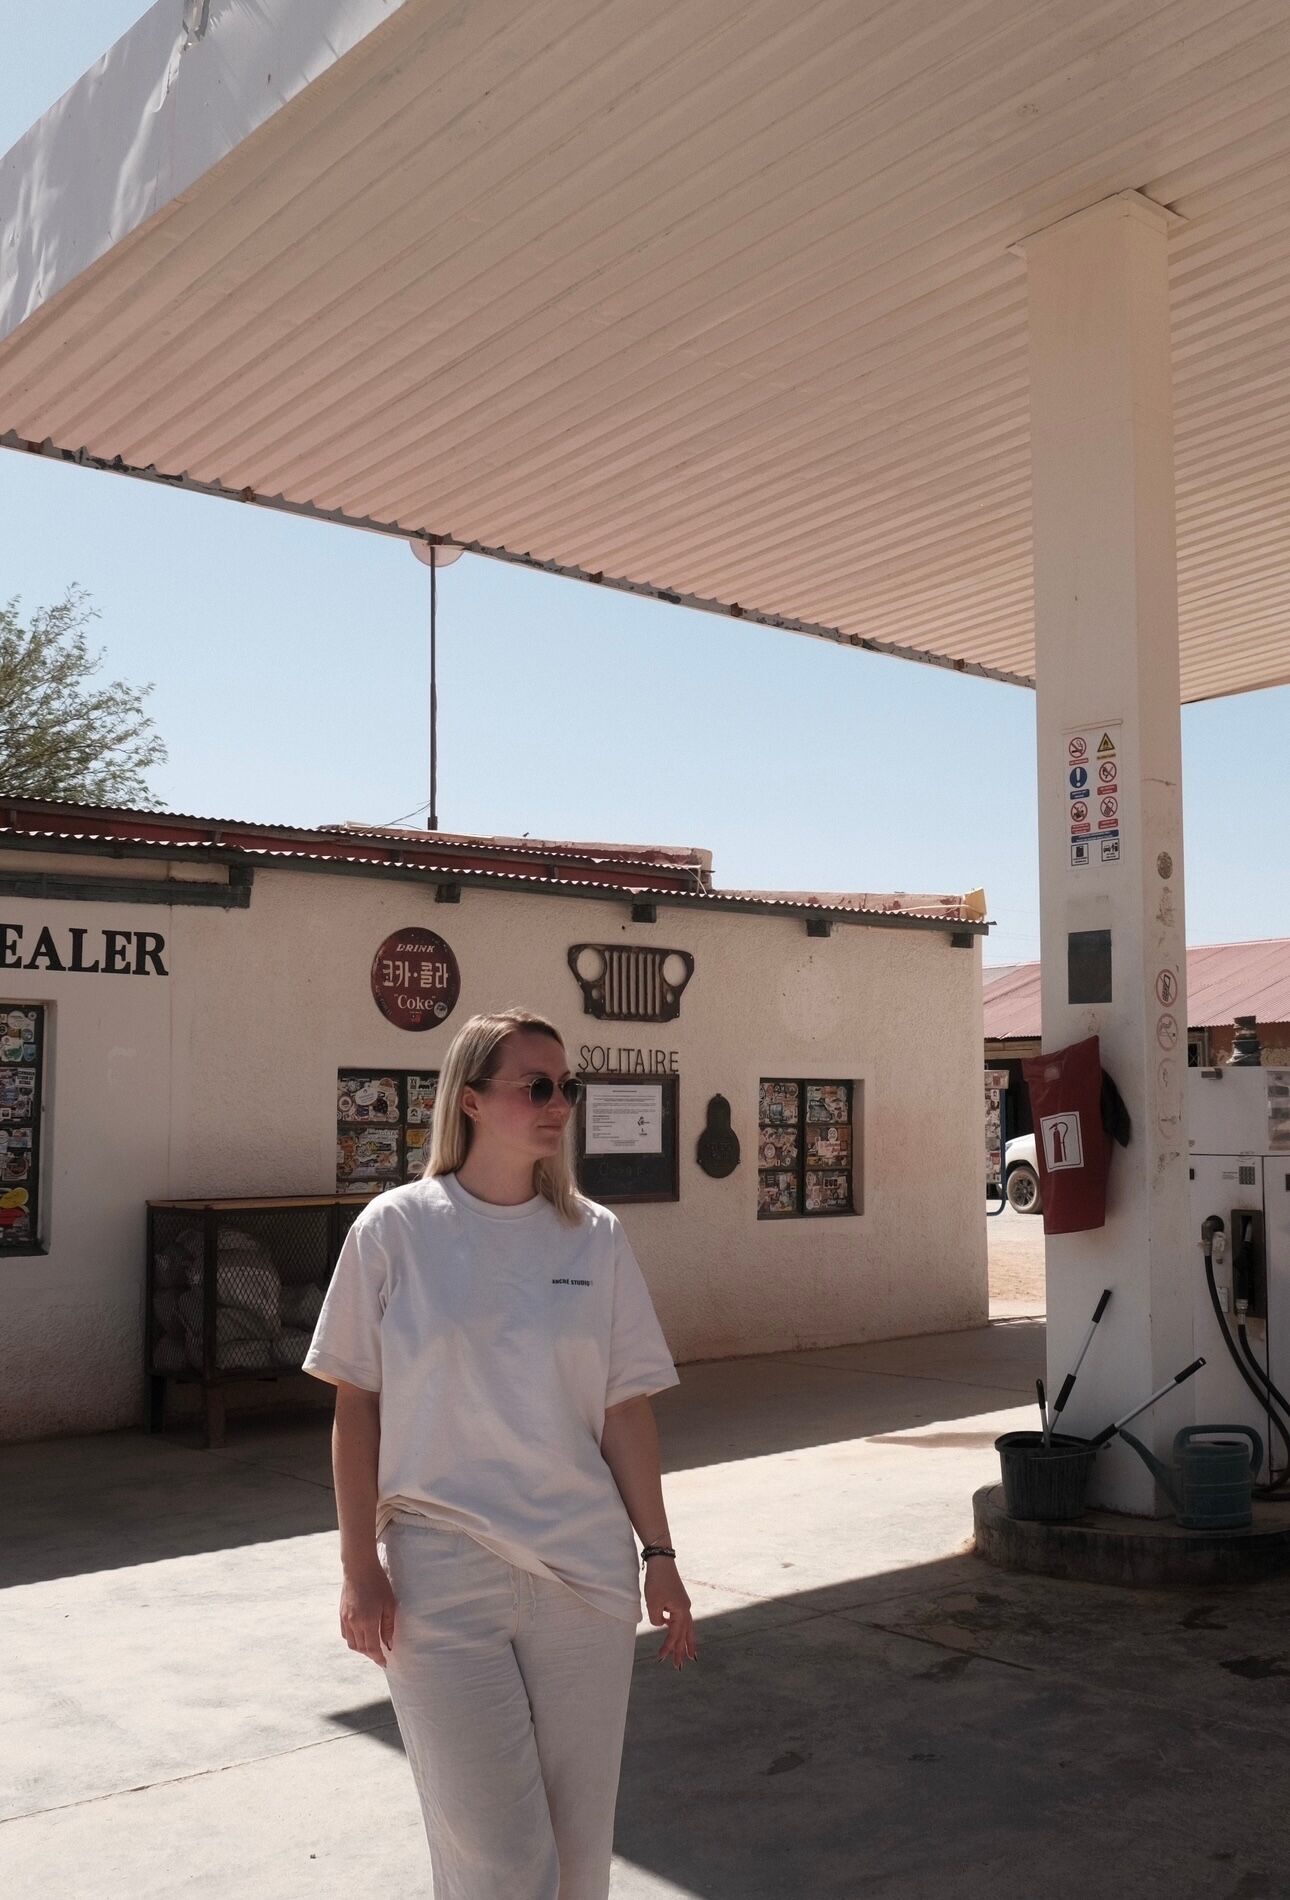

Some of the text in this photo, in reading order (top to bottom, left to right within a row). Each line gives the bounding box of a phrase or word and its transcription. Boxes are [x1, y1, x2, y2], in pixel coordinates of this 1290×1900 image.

[0, 923, 169, 976] EALER
[396, 943, 435, 953] DRINK
[382, 960, 449, 988] 코카·콜라
[578, 1045, 679, 1074] SOLITAIRE
